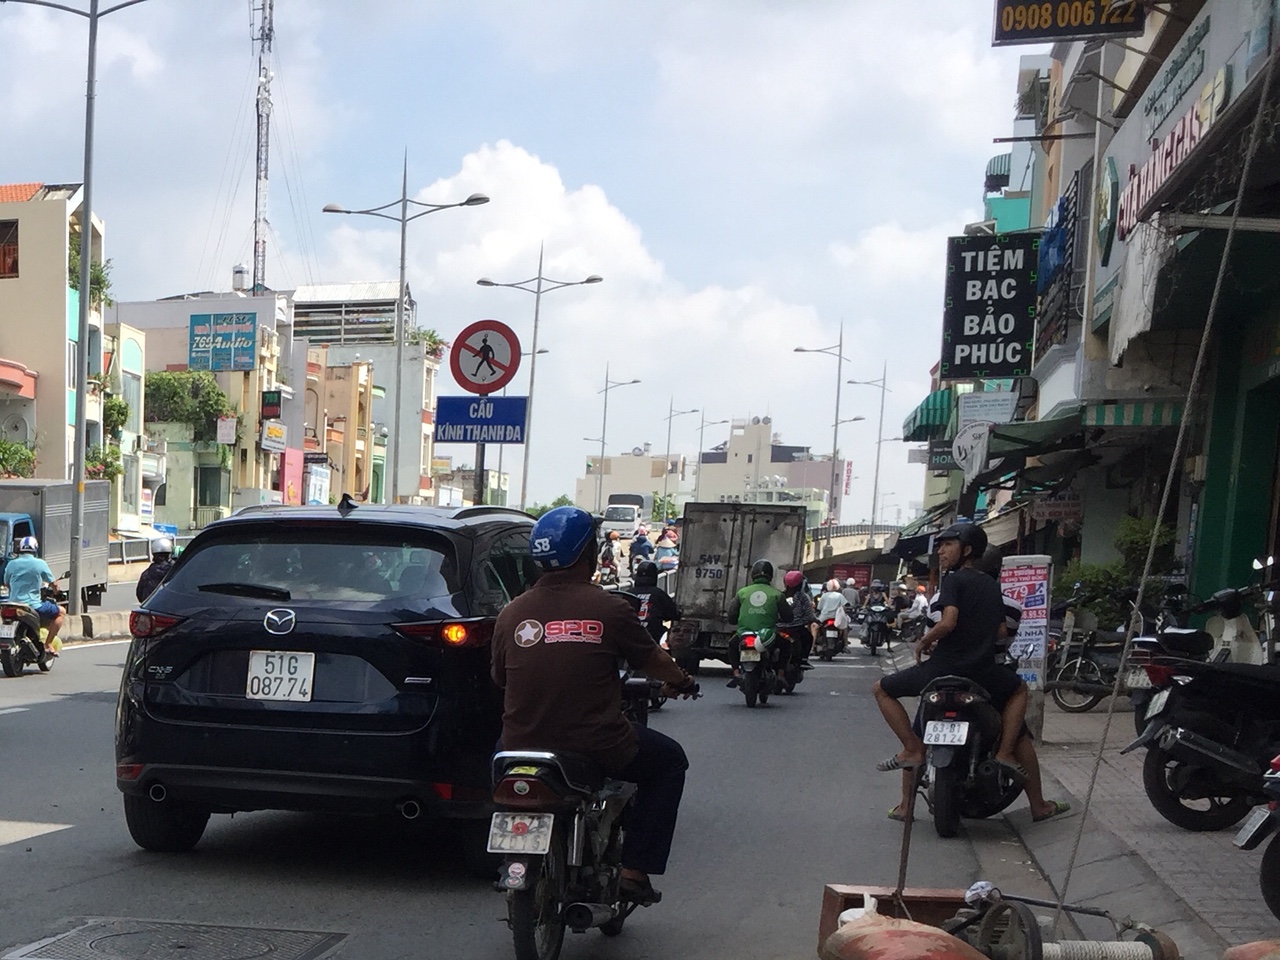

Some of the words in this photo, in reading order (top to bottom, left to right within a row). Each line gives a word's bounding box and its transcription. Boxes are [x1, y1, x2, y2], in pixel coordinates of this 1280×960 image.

[1001, 2, 1053, 32] 0908
[1056, 0, 1096, 28] 006
[961, 244, 1024, 276] TIỆM
[965, 278, 1017, 305] BẠC
[963, 306, 1015, 336] BẢO
[954, 337, 1022, 365] PHÚC
[469, 398, 494, 418] CẦU
[437, 422, 465, 441] KÍNH
[466, 424, 505, 441] THANH
[505, 425, 521, 441] ĐA
[844, 460, 853, 496] HOTEL
[695, 568, 723, 579] 9750
[748, 607, 767, 615] Grab
[545, 620, 604, 637] SPD
[265, 655, 298, 675] 51G
[250, 676, 309, 697] 087.74
